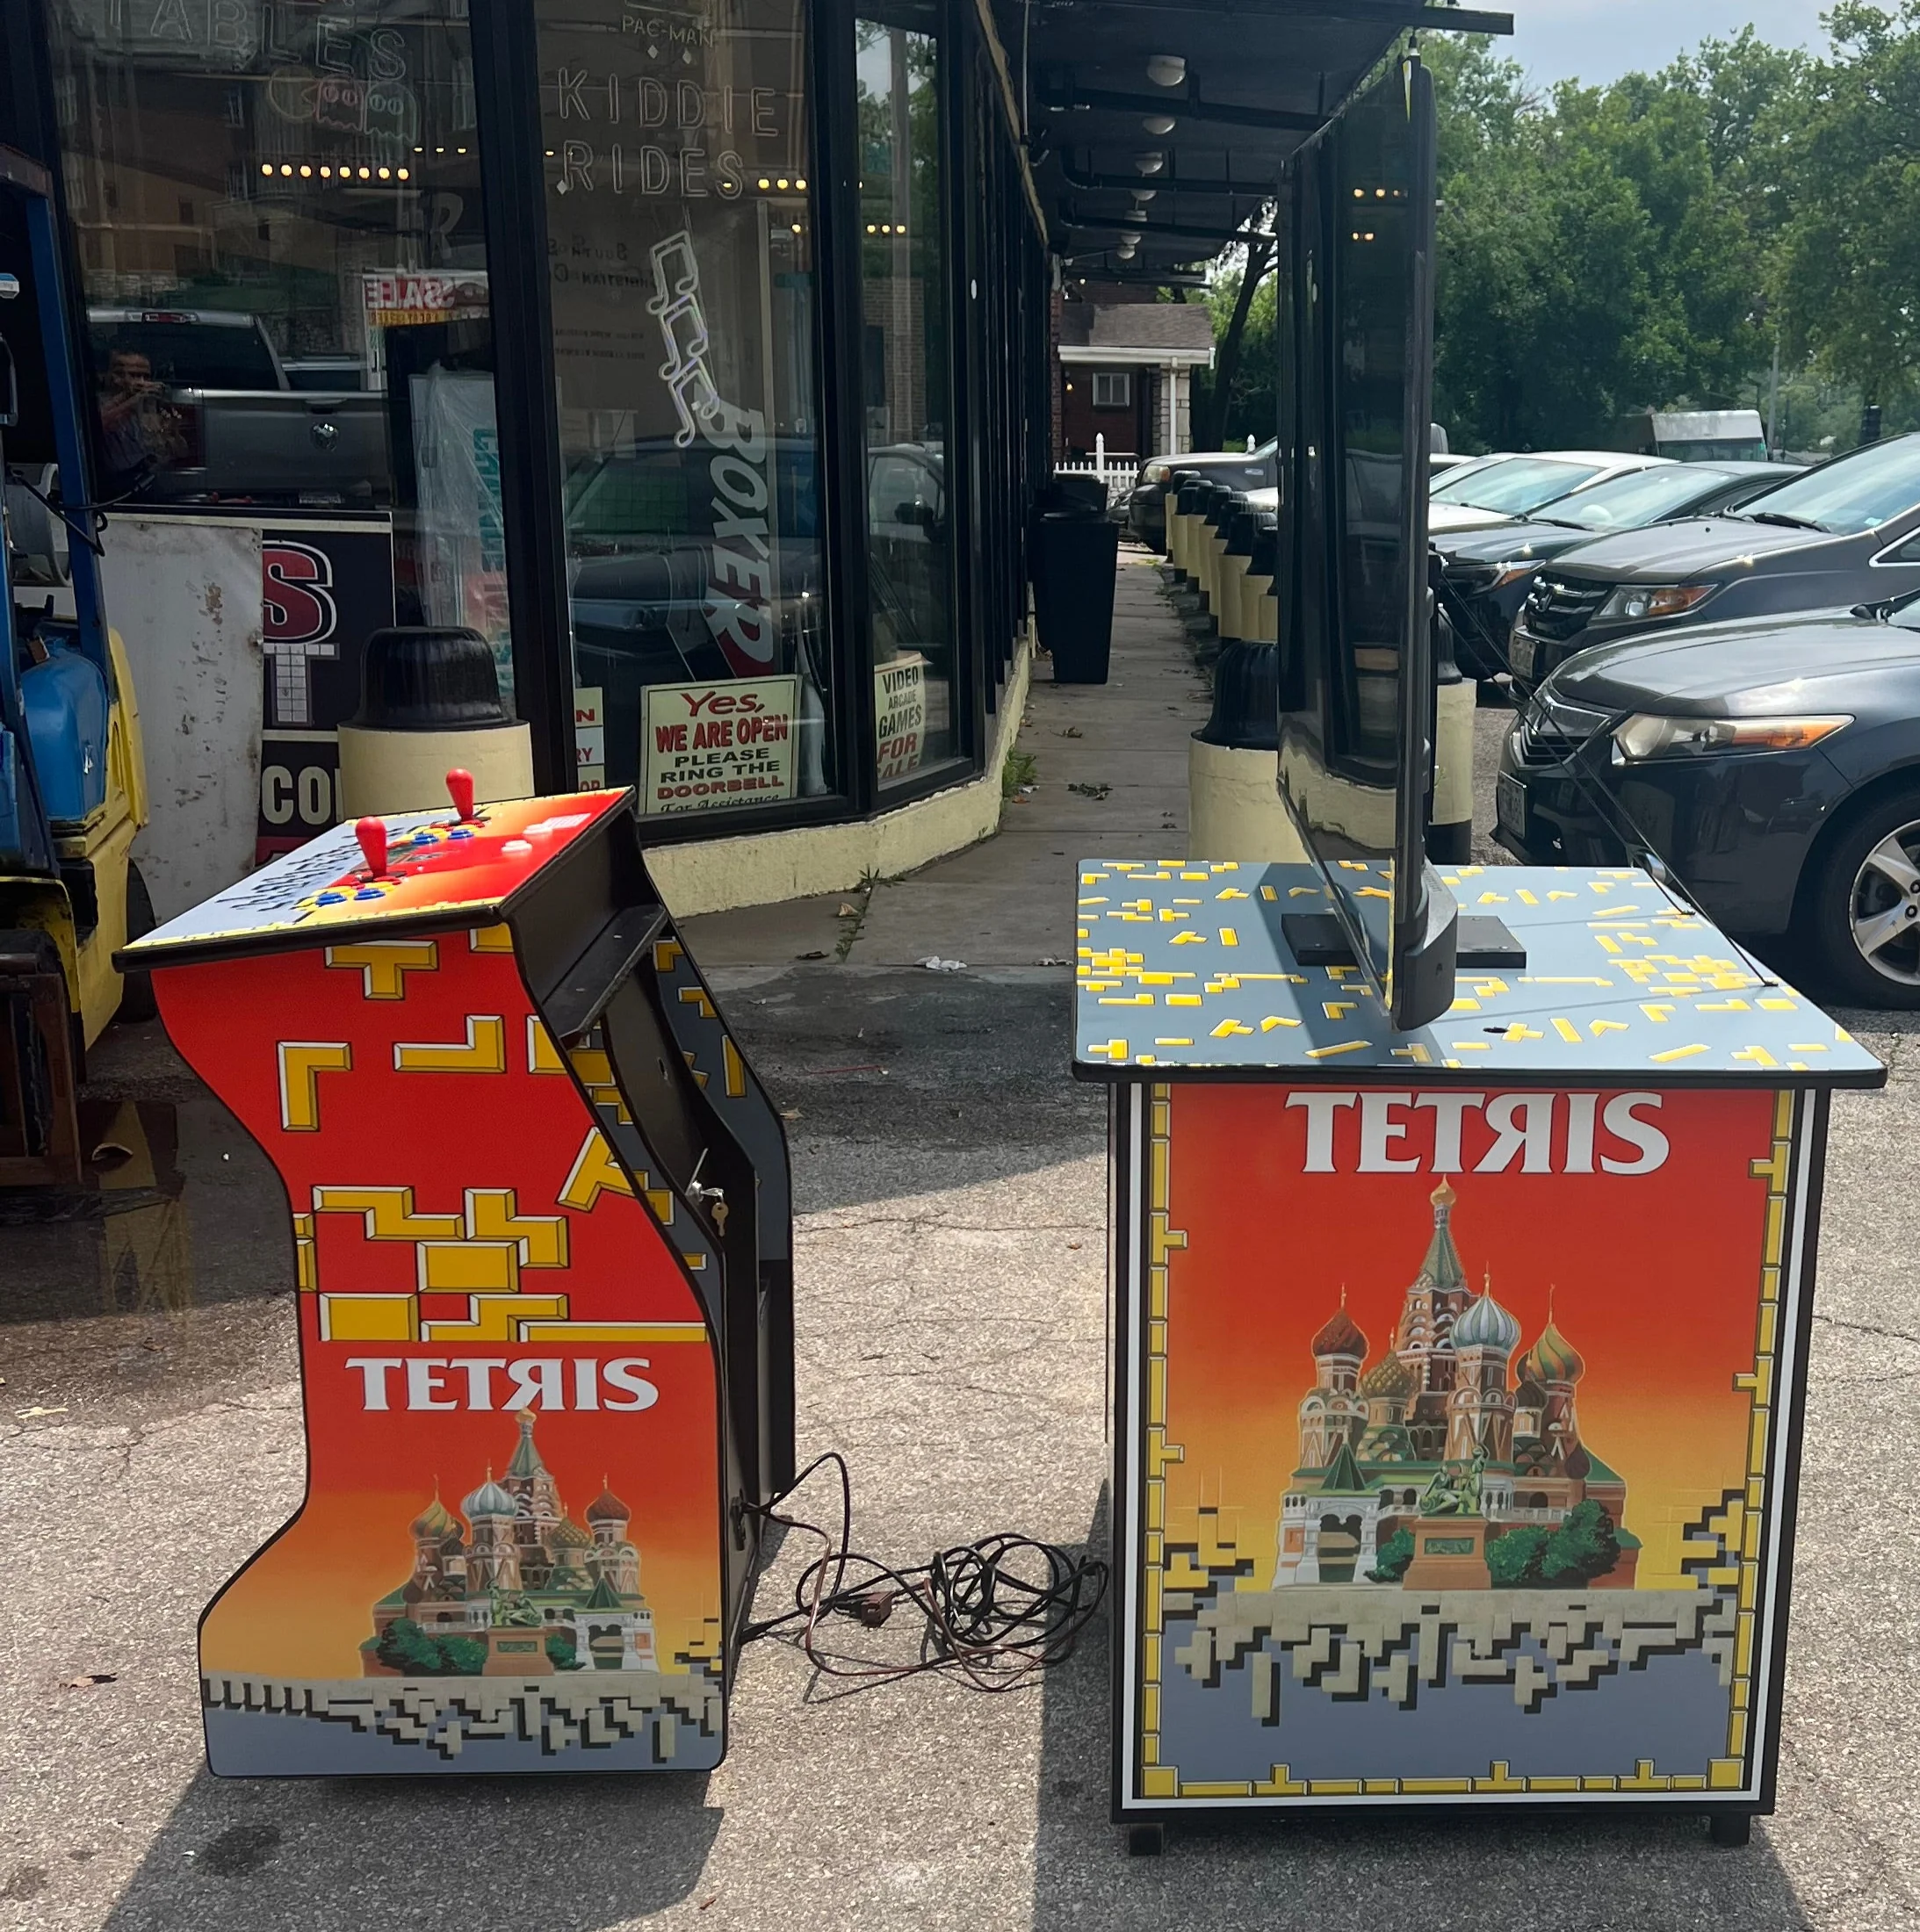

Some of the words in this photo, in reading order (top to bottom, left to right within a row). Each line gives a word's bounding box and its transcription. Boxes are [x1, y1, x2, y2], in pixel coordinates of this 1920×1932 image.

[622, 14, 714, 48] PAC-MAN
[557, 67, 779, 138] KIDDIE
[561, 139, 745, 200] RIDES
[691, 386, 775, 664] BOXER
[882, 666, 919, 695] VIDEO
[680, 690, 765, 717] Yes,
[888, 689, 917, 710] ARCADE
[655, 724, 688, 753] WE
[692, 719, 733, 750] ARE
[736, 714, 789, 746] OPEN
[878, 703, 922, 739] GAMES
[675, 747, 770, 768] PLEASE
[877, 732, 918, 764] FOR
[660, 768, 724, 783] RING
[732, 761, 780, 775] THE
[878, 753, 920, 778] ALE
[657, 775, 784, 800] DOORBELL
